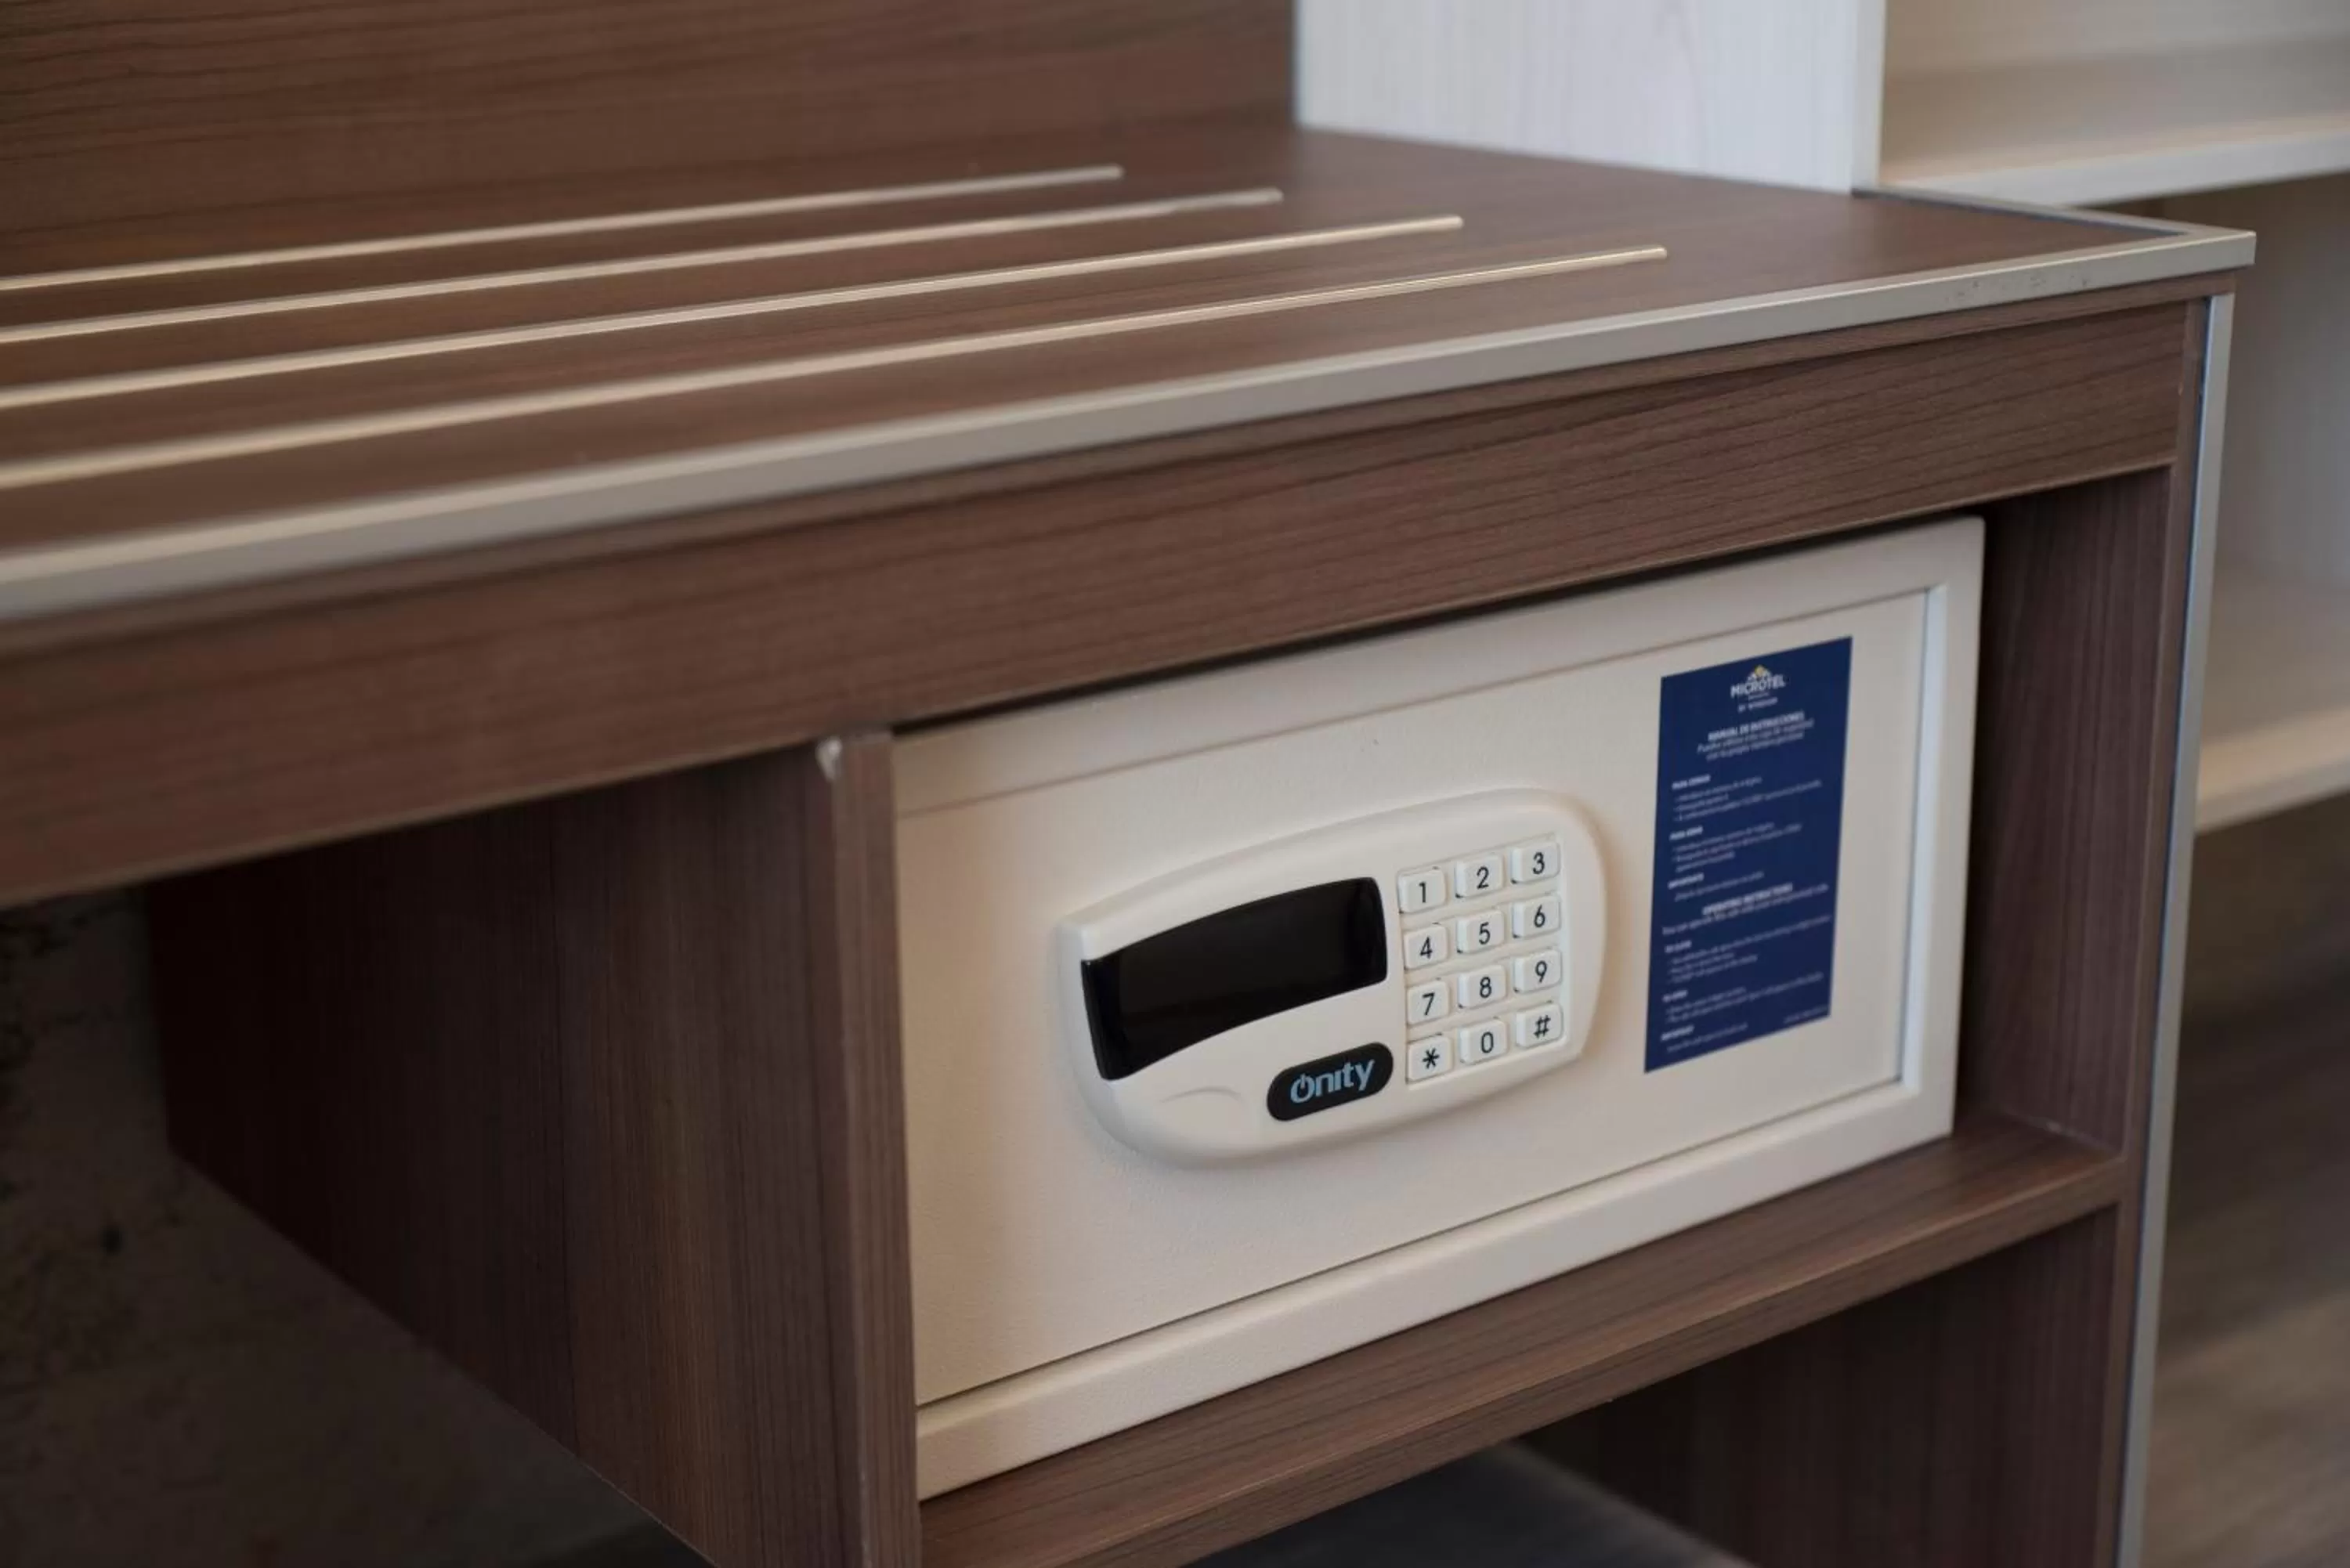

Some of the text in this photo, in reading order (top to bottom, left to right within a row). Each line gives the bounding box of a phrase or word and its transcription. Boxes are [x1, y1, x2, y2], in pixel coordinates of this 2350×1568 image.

[1730, 674, 1786, 698] MICROTEL
[1418, 852, 1546, 904] 1 2 3
[1419, 905, 1546, 959] 4 5 6
[1422, 960, 1548, 1016] 7 8 9
[1480, 1031, 1495, 1053] 0
[1289, 1059, 1376, 1104] Onity
